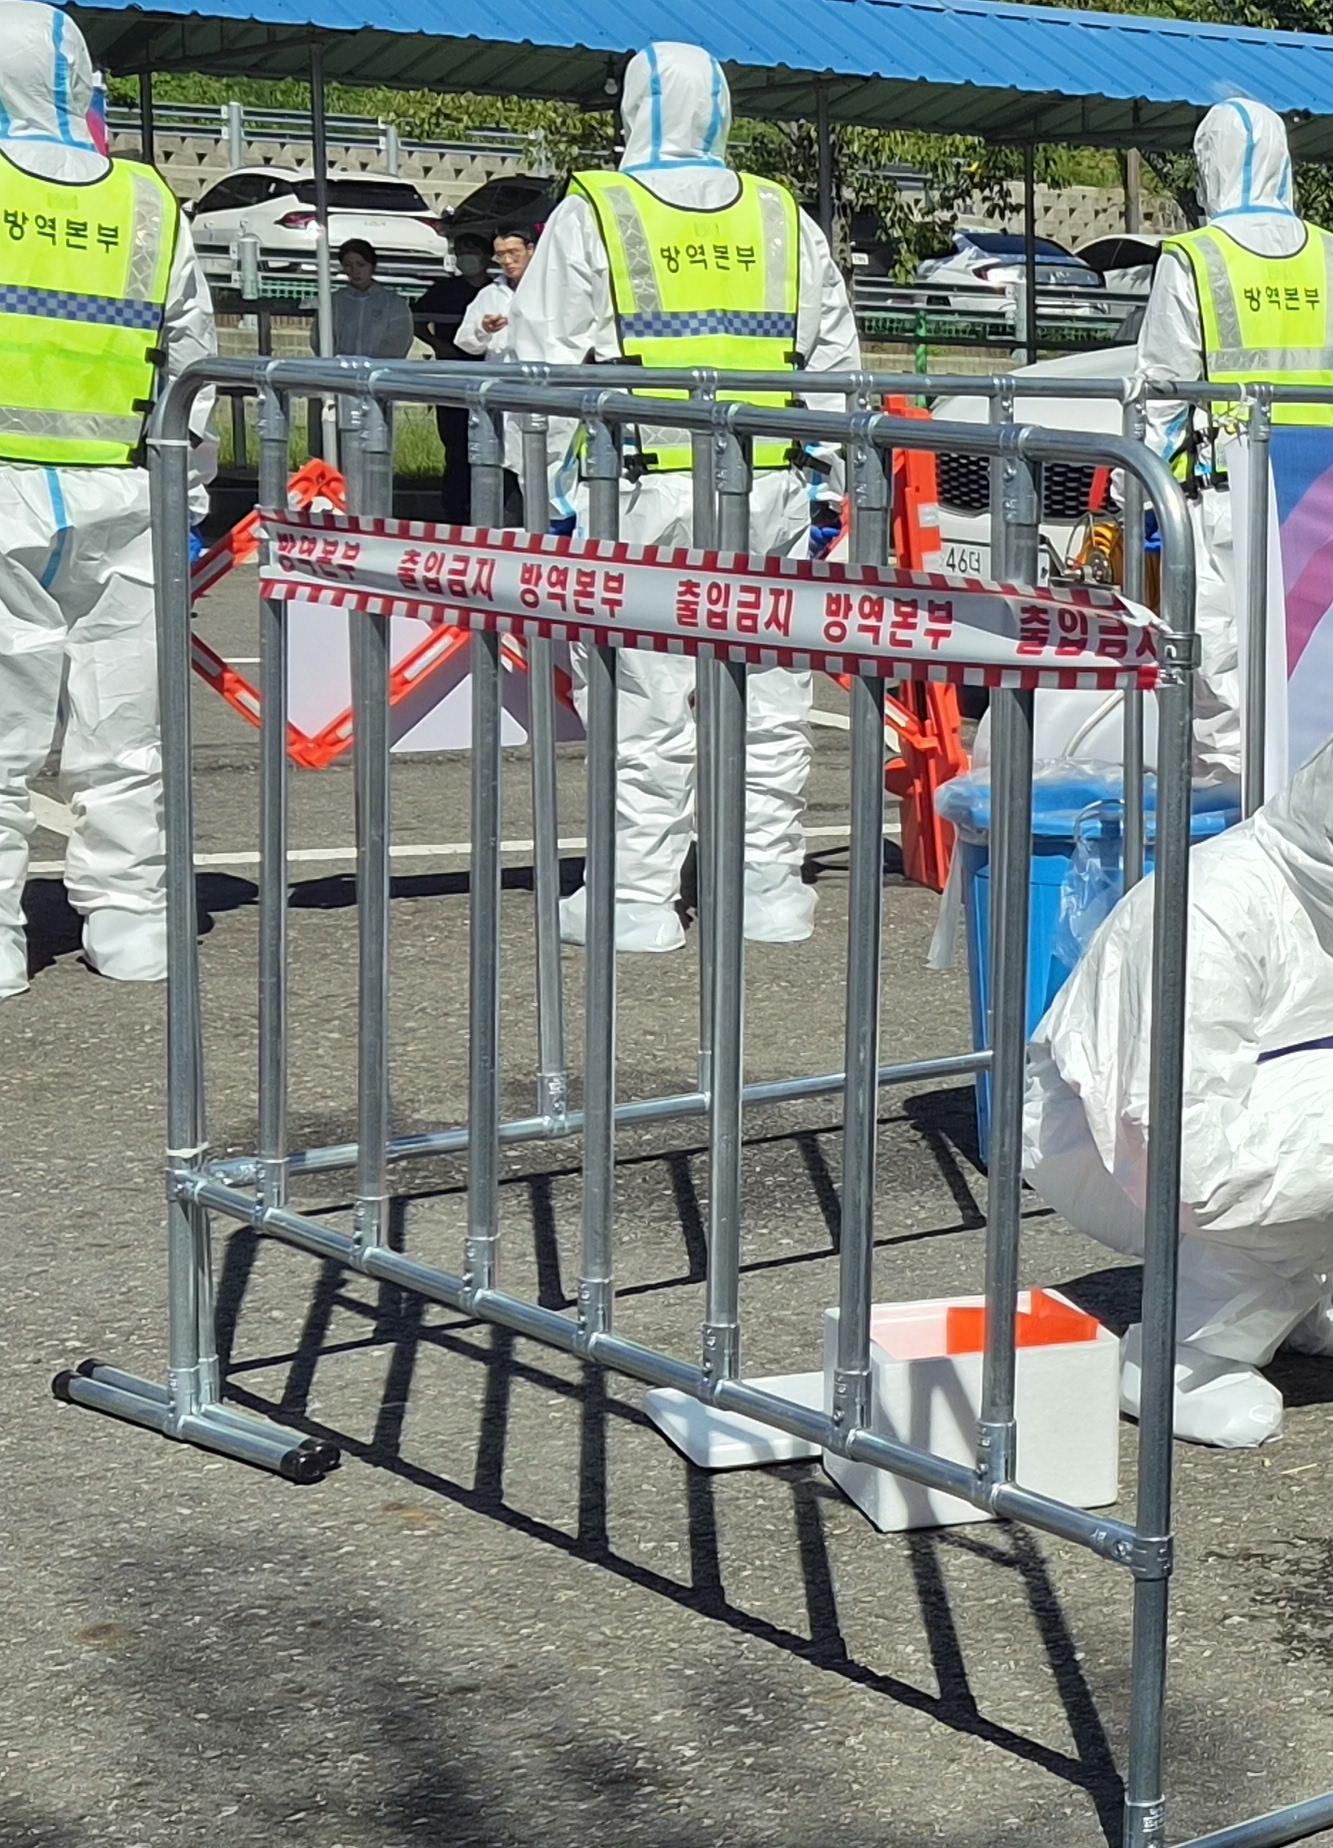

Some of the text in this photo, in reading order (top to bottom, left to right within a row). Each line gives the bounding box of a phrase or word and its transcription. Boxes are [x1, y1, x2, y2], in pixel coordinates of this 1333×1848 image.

[4, 209, 119, 254] 방역본부
[660, 244, 756, 273] 방역본부
[1244, 286, 1320, 312] 방역본부
[277, 531, 361, 580] 방역본부
[397, 549, 496, 602] 출입금지
[519, 562, 625, 618] 방역본부
[675, 579, 794, 637] 출입금지
[824, 593, 954, 650] 방역본부
